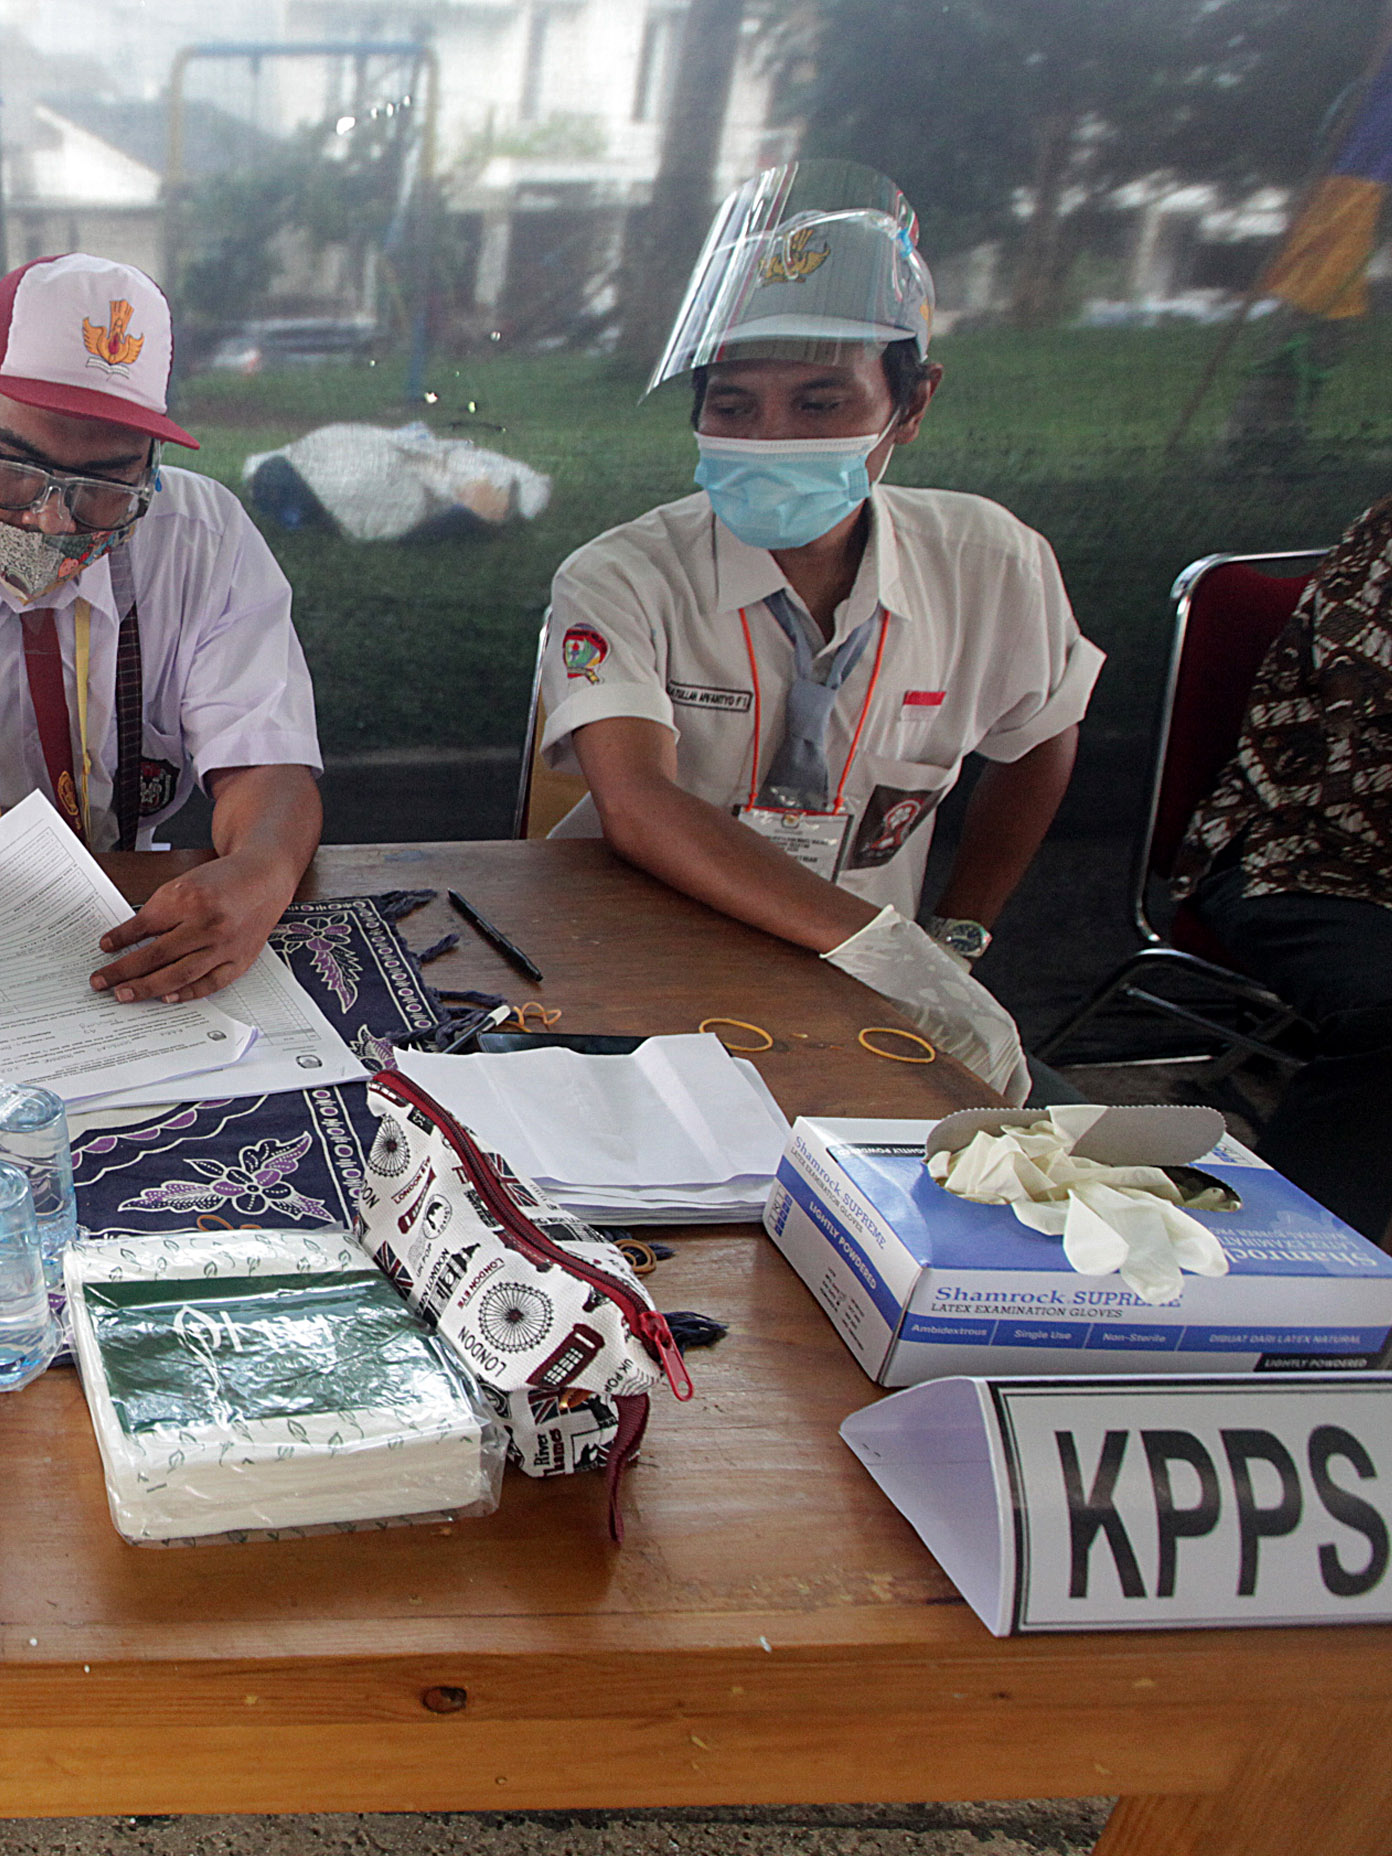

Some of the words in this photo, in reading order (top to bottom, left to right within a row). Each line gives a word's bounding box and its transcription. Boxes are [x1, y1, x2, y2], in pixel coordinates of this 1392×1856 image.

[393, 1173, 422, 1204] LONDON
[795, 1136, 842, 1196] Shamrock
[842, 1193, 886, 1250] SUPREME
[809, 1201, 839, 1239] LIGHTLY
[838, 1236, 876, 1290] POWDERED
[426, 1248, 450, 1289] LONDON
[469, 1257, 504, 1290] LONDON
[931, 1302, 972, 1313] LATEX
[974, 1304, 1067, 1317] EXAMINATION
[1069, 1307, 1123, 1318] GLOVES
[935, 1286, 1066, 1305] Shamrock
[1072, 1290, 1183, 1308] SUPREE
[911, 1324, 987, 1336] Ambidextrous
[1014, 1329, 1048, 1340] Single
[1050, 1331, 1072, 1340] Use
[1102, 1332, 1167, 1343] Non-Sterile
[1209, 1334, 1248, 1343] DIBUAT
[1312, 1335, 1361, 1344] NATURAL
[457, 1326, 507, 1377] LONDON
[1265, 1358, 1308, 1367] LIGHTLY
[1308, 1358, 1368, 1368] POWDERED
[620, 1358, 633, 1373] UK
[533, 1433, 550, 1466] River
[1054, 1424, 1391, 1599] KPPS
